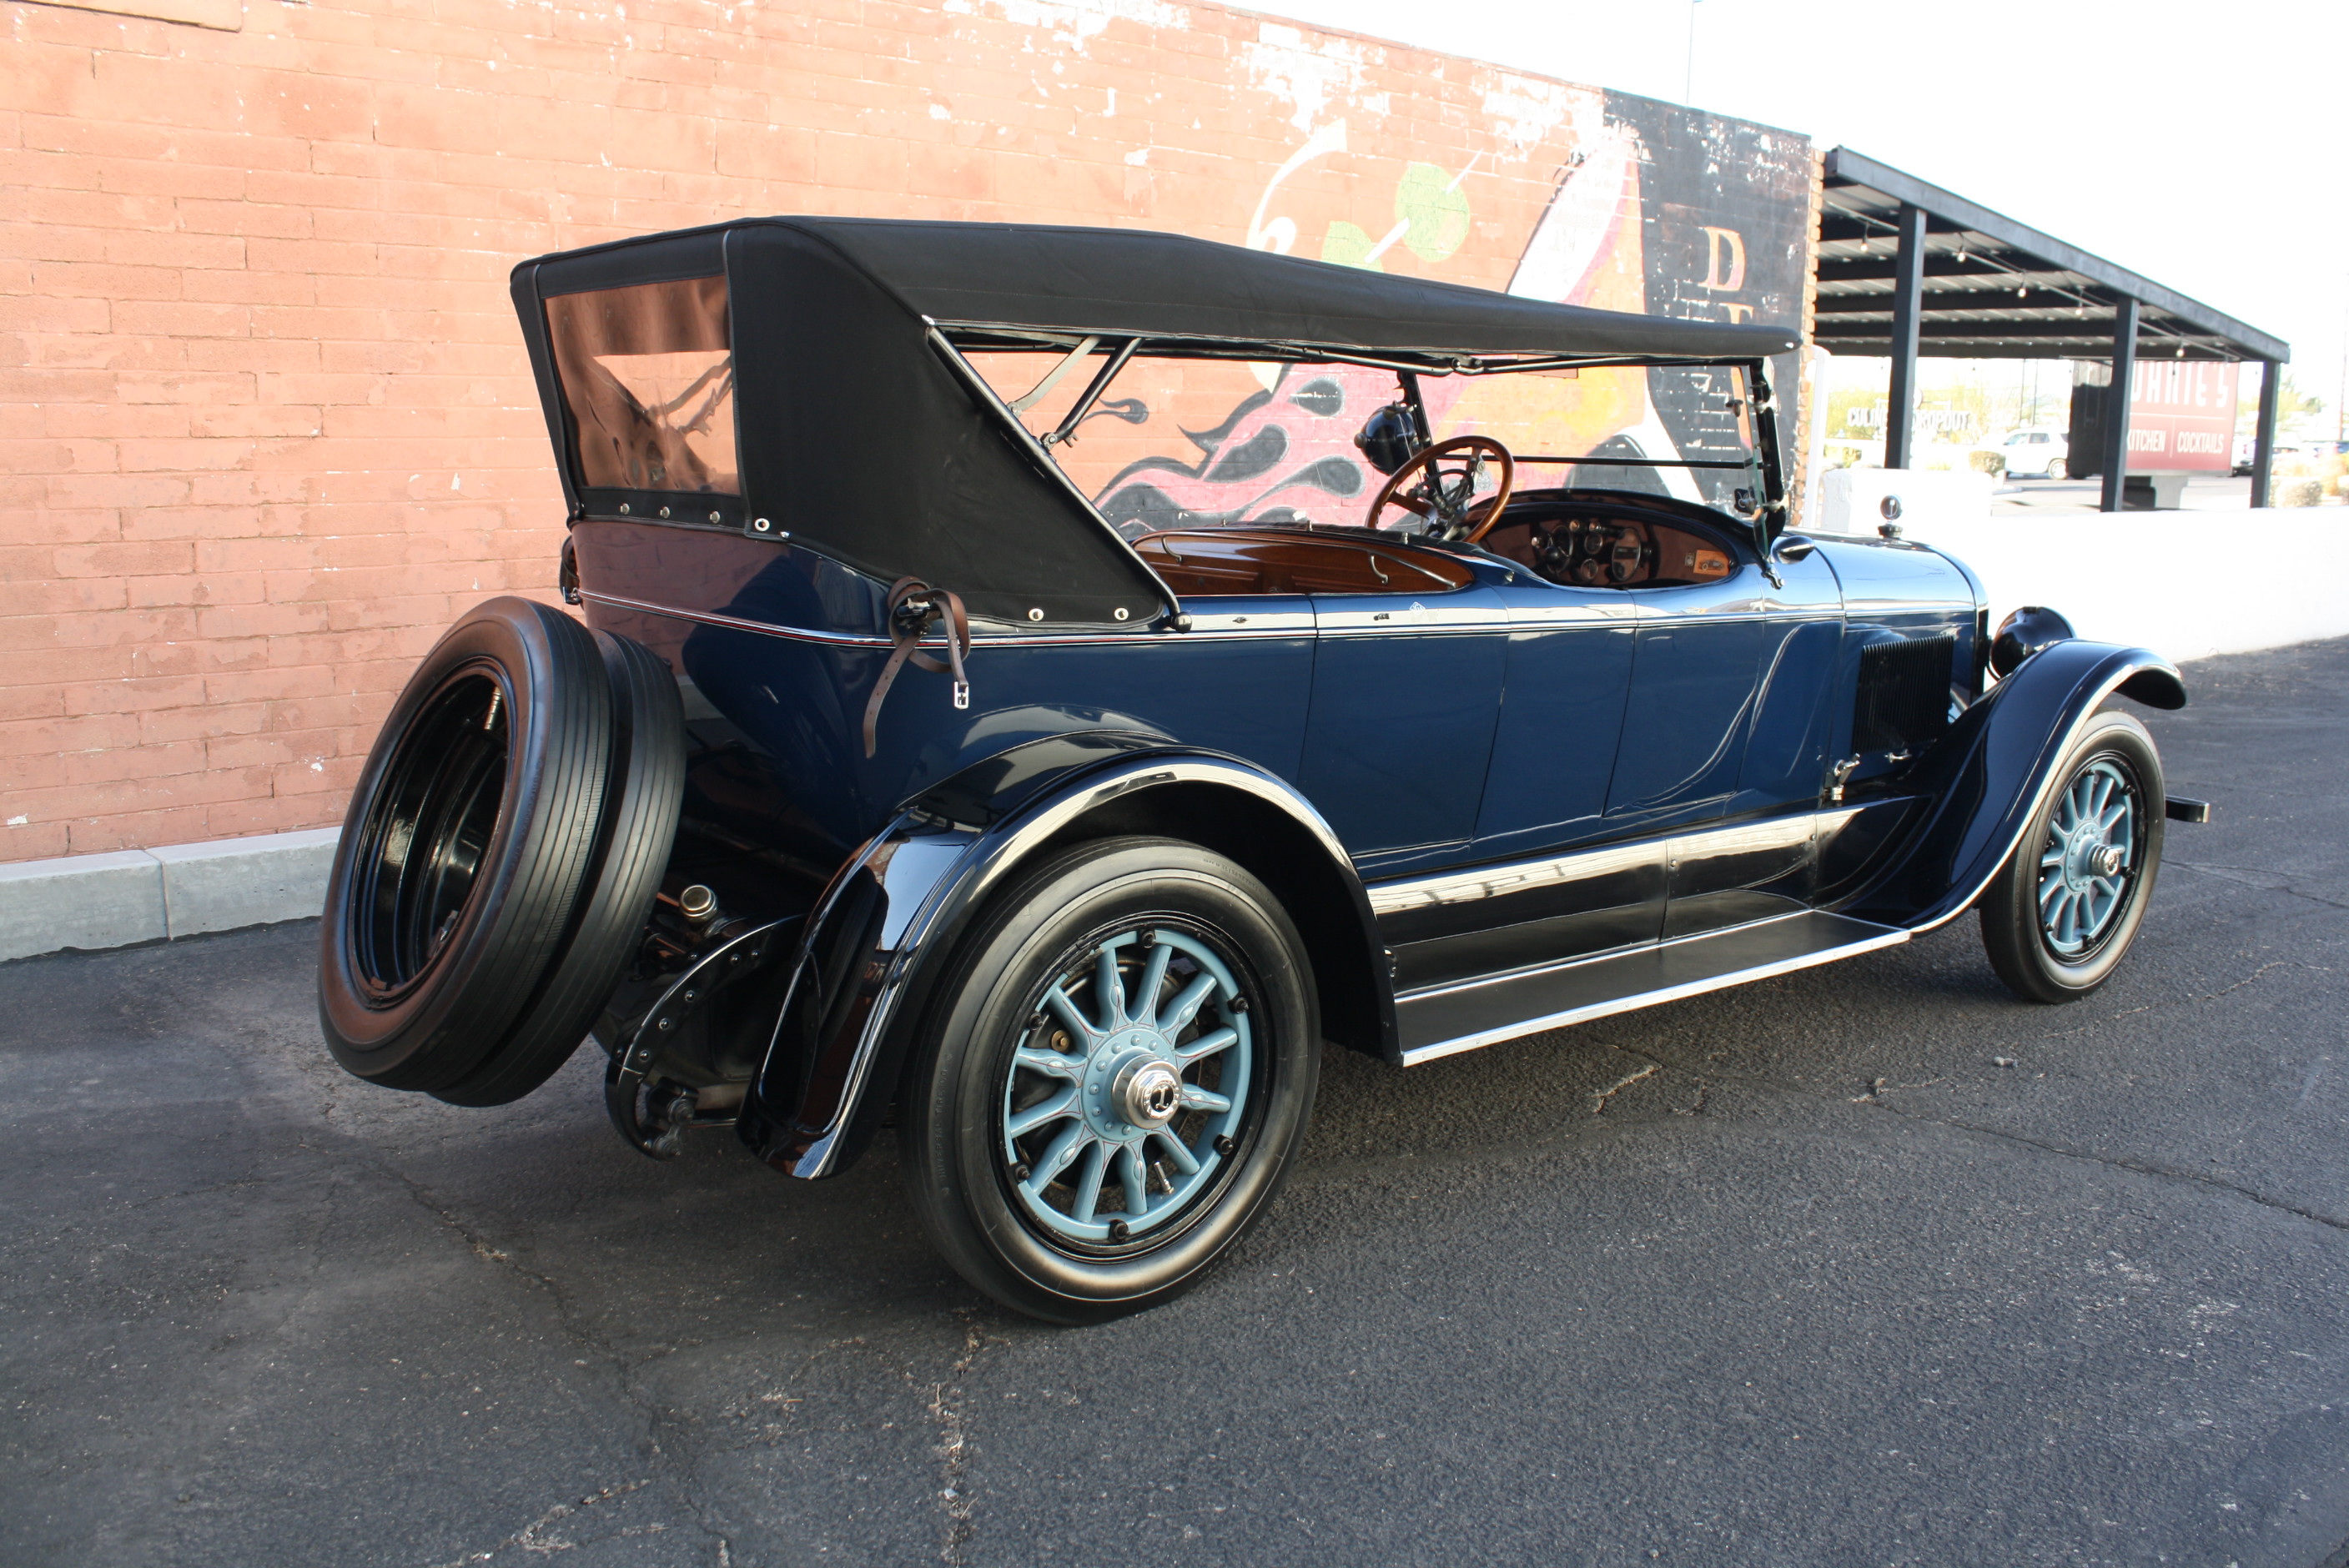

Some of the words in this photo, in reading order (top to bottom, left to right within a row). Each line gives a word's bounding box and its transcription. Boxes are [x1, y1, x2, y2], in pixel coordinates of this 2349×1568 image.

[1698, 226, 1746, 291] D
[1847, 406, 1888, 427] CULIN
[2126, 429, 2166, 453] KITCHEN
[2176, 430, 2225, 455] COCKTAILS
